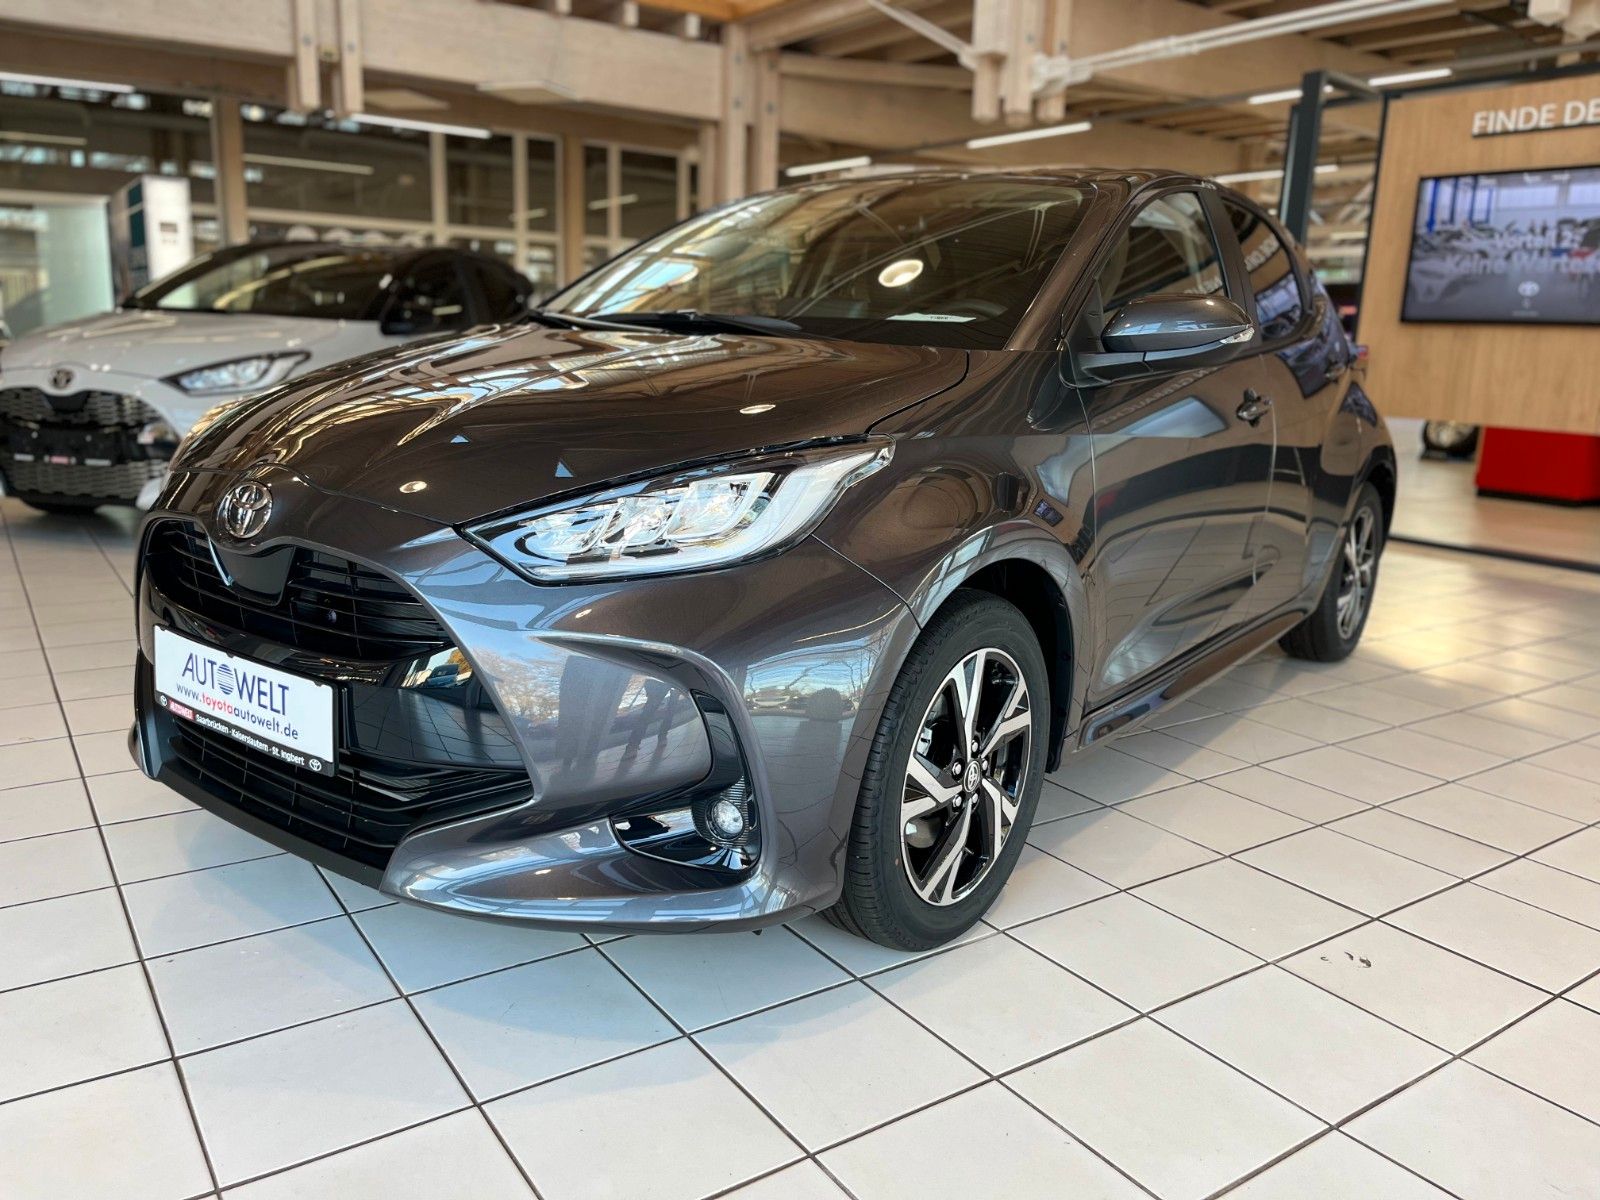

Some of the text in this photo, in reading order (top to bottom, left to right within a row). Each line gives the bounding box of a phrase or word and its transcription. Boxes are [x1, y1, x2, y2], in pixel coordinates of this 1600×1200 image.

[1472, 103, 1557, 135] FINDE
[176, 682, 299, 740] www.toyotaautowelt.de
[181, 652, 290, 716] AUTOWELT
[196, 713, 229, 734] Saarbrücken
[281, 748, 305, 766] Ingbert
